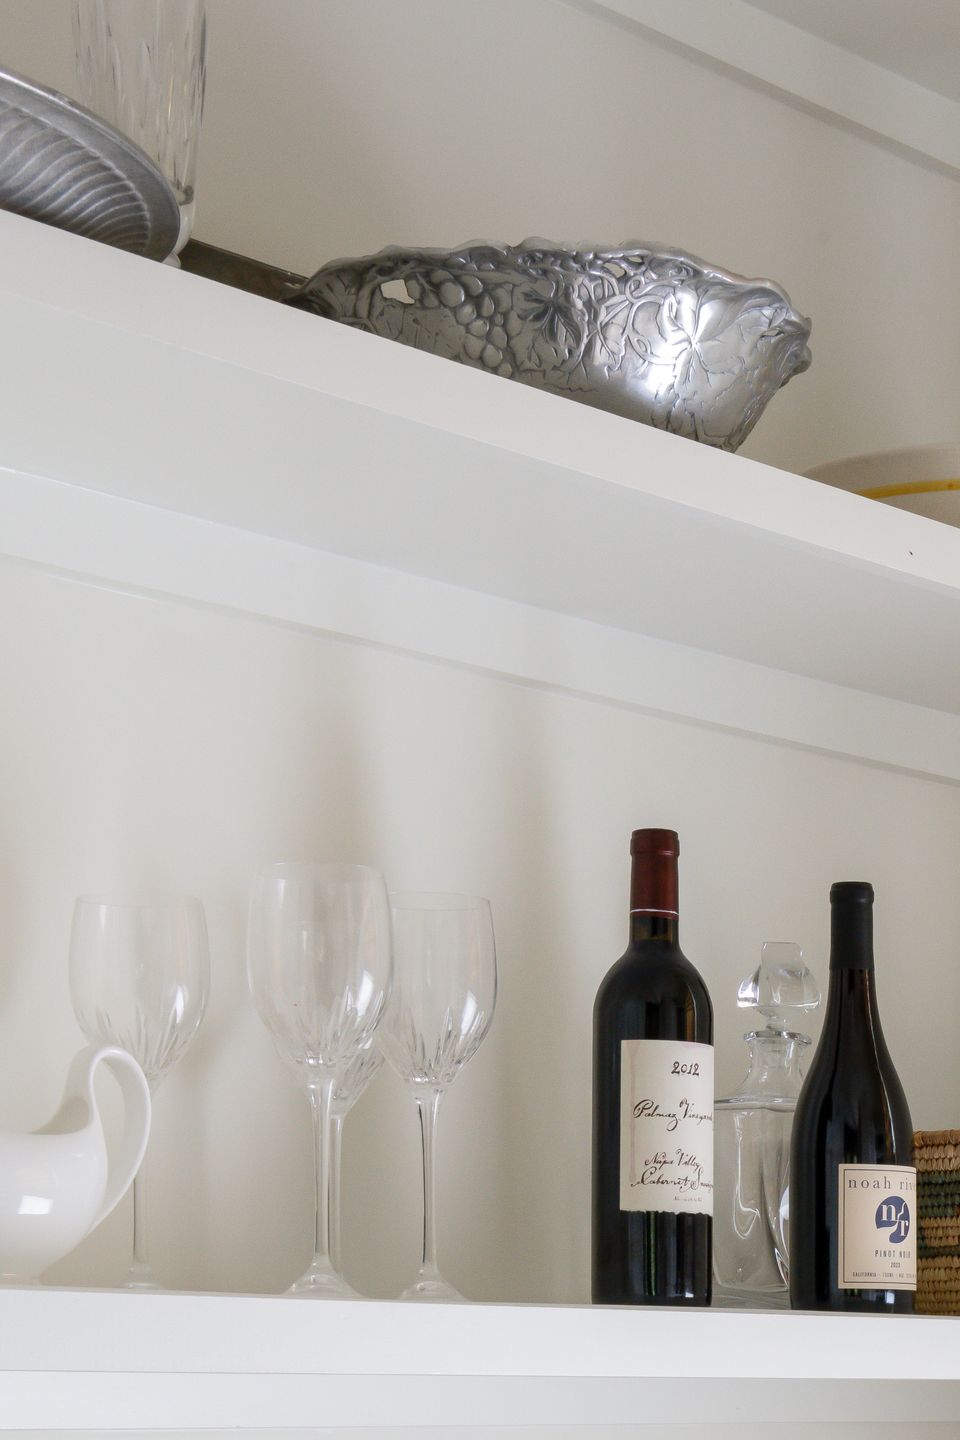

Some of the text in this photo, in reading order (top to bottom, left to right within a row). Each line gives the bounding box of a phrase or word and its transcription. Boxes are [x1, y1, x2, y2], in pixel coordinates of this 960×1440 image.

[670, 1061, 700, 1076] 2012
[632, 1099, 679, 1132] Palmaz
[630, 1166, 692, 1189] Cabernet
[848, 1176, 891, 1189] noah
[874, 1249, 896, 1258] PINOT
